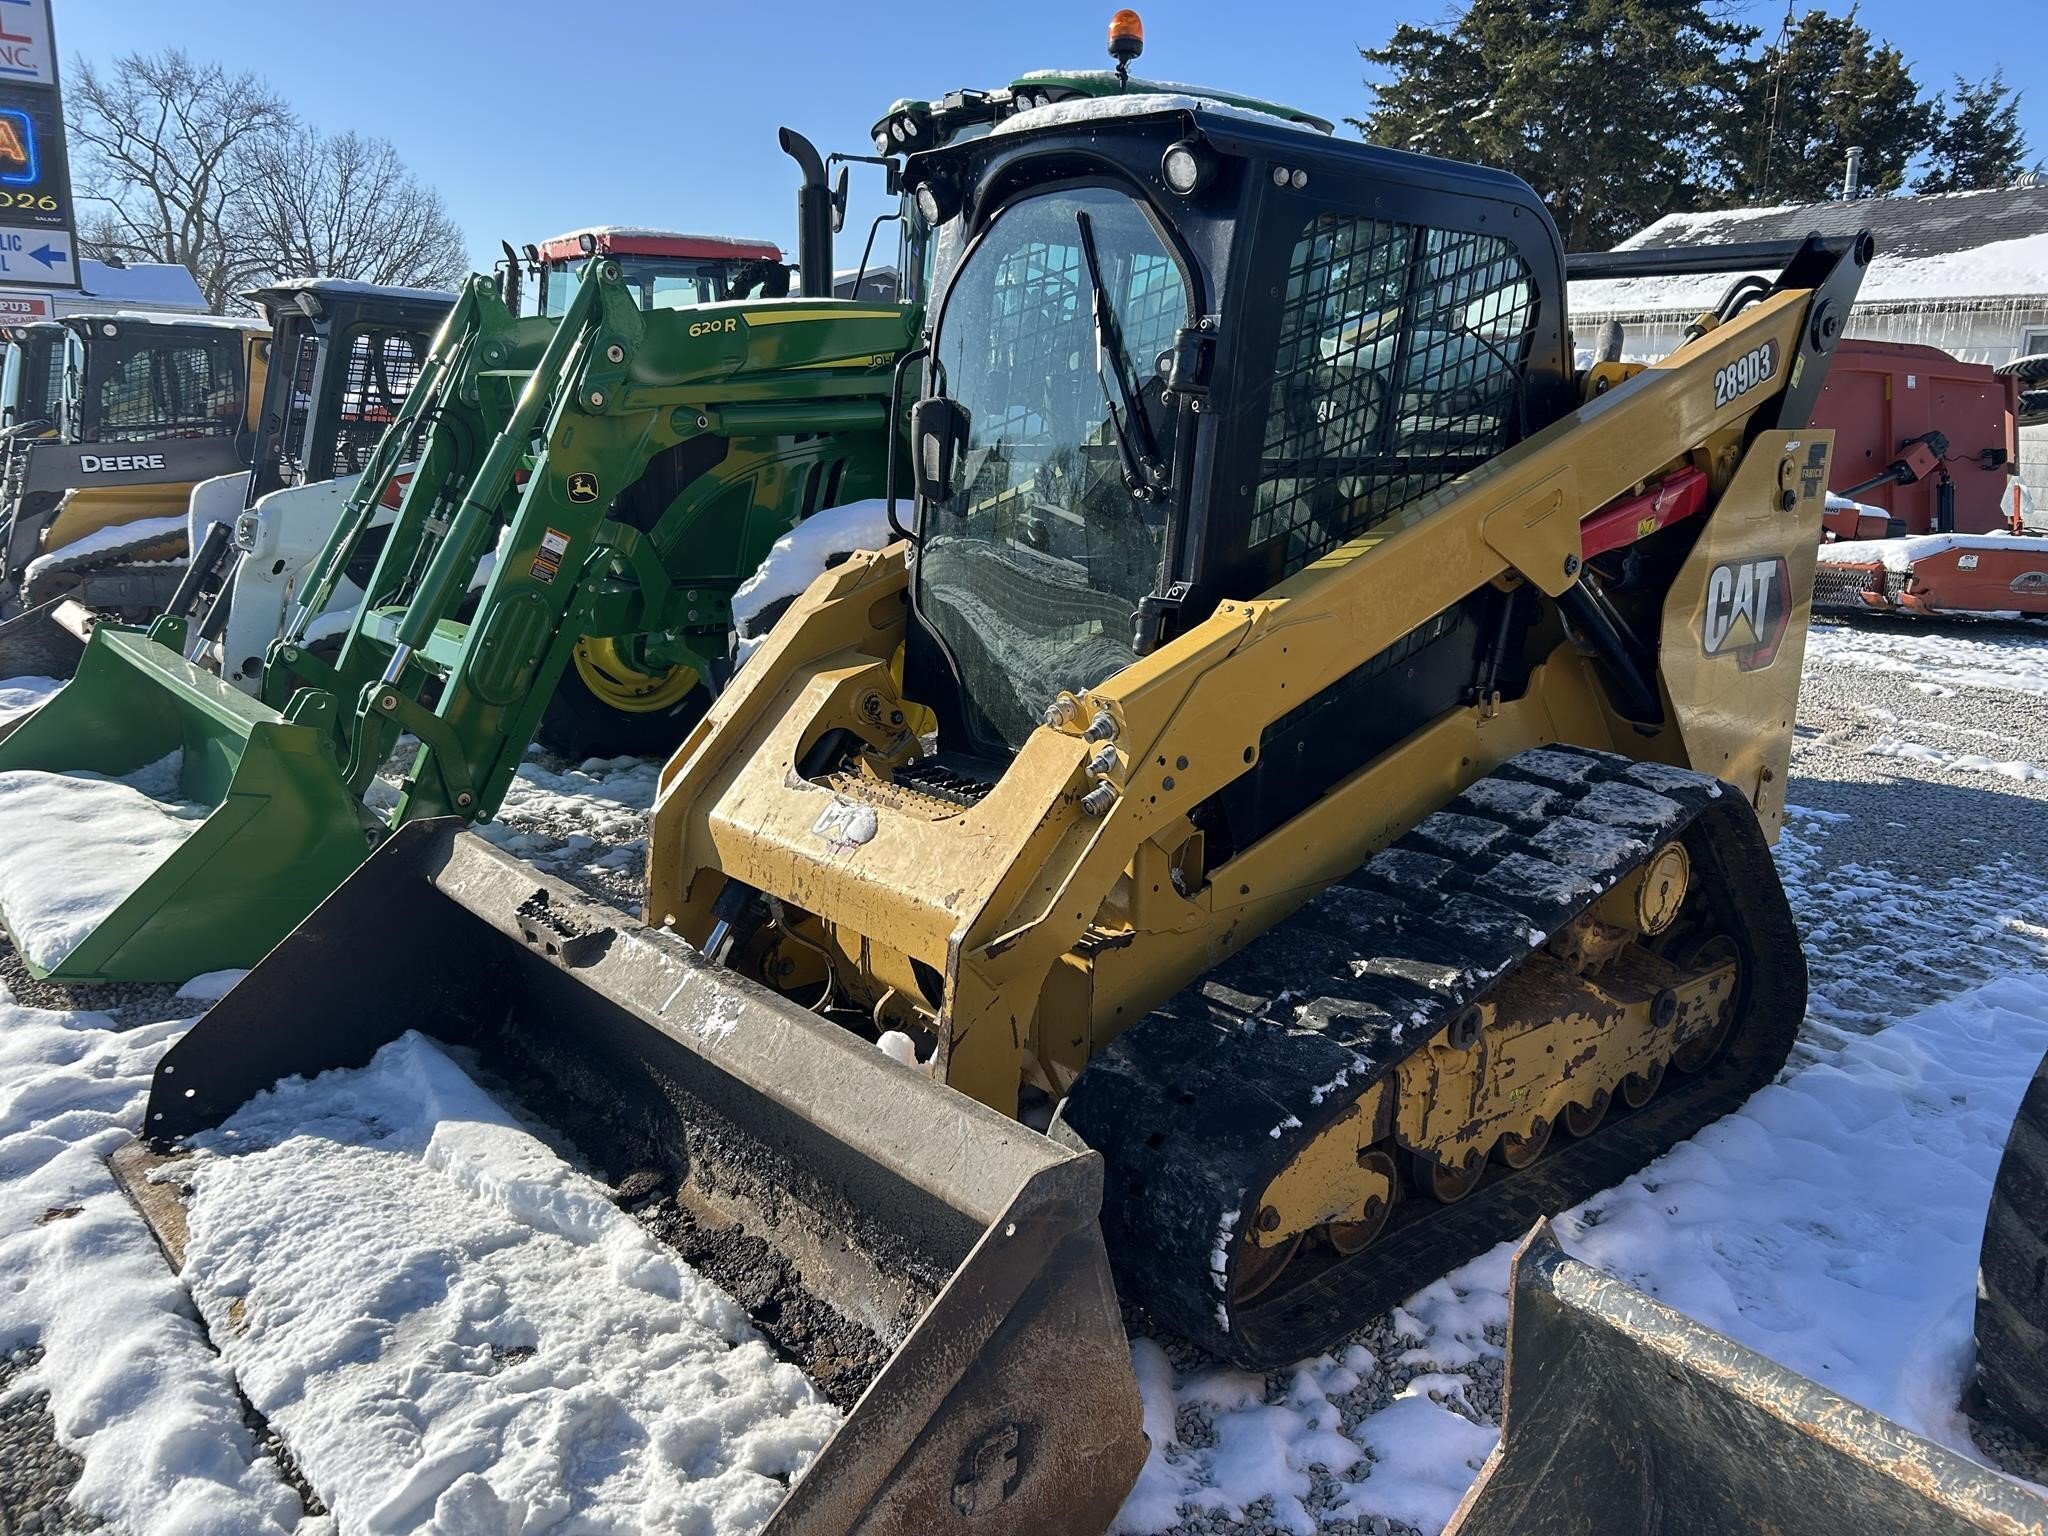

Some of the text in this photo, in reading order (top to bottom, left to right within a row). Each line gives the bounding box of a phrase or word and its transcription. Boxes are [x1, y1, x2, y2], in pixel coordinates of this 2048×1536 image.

[0, 301, 31, 312] PUB
[1714, 343, 1771, 409] 289D3
[80, 454, 165, 473] DEERE
[1704, 560, 1777, 653] CAT
